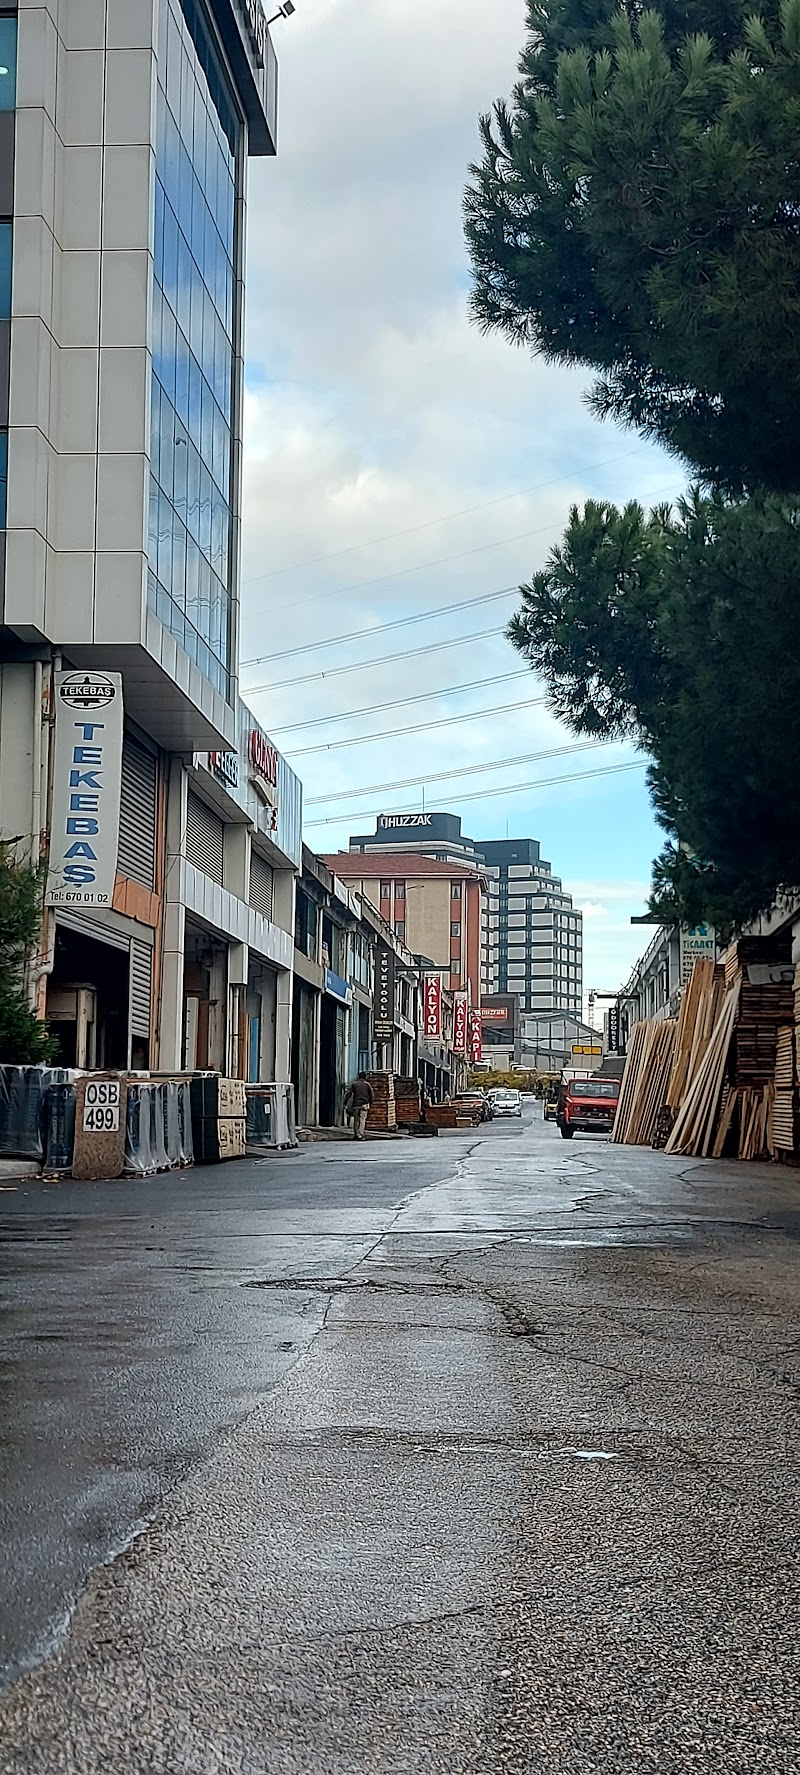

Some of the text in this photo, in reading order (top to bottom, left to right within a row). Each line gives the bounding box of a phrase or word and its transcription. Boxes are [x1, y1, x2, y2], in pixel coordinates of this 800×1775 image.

[62, 686, 112, 697] TEKEBAŞ
[62, 722, 105, 888] TEKEBAŞ
[50, 891, 109, 903] Tel: 670 01 02
[427, 977, 437, 1034] KALYON
[455, 999, 465, 1047] KALYON
[471, 1022, 481, 1061] KAPI
[87, 1083, 118, 1104] OSB
